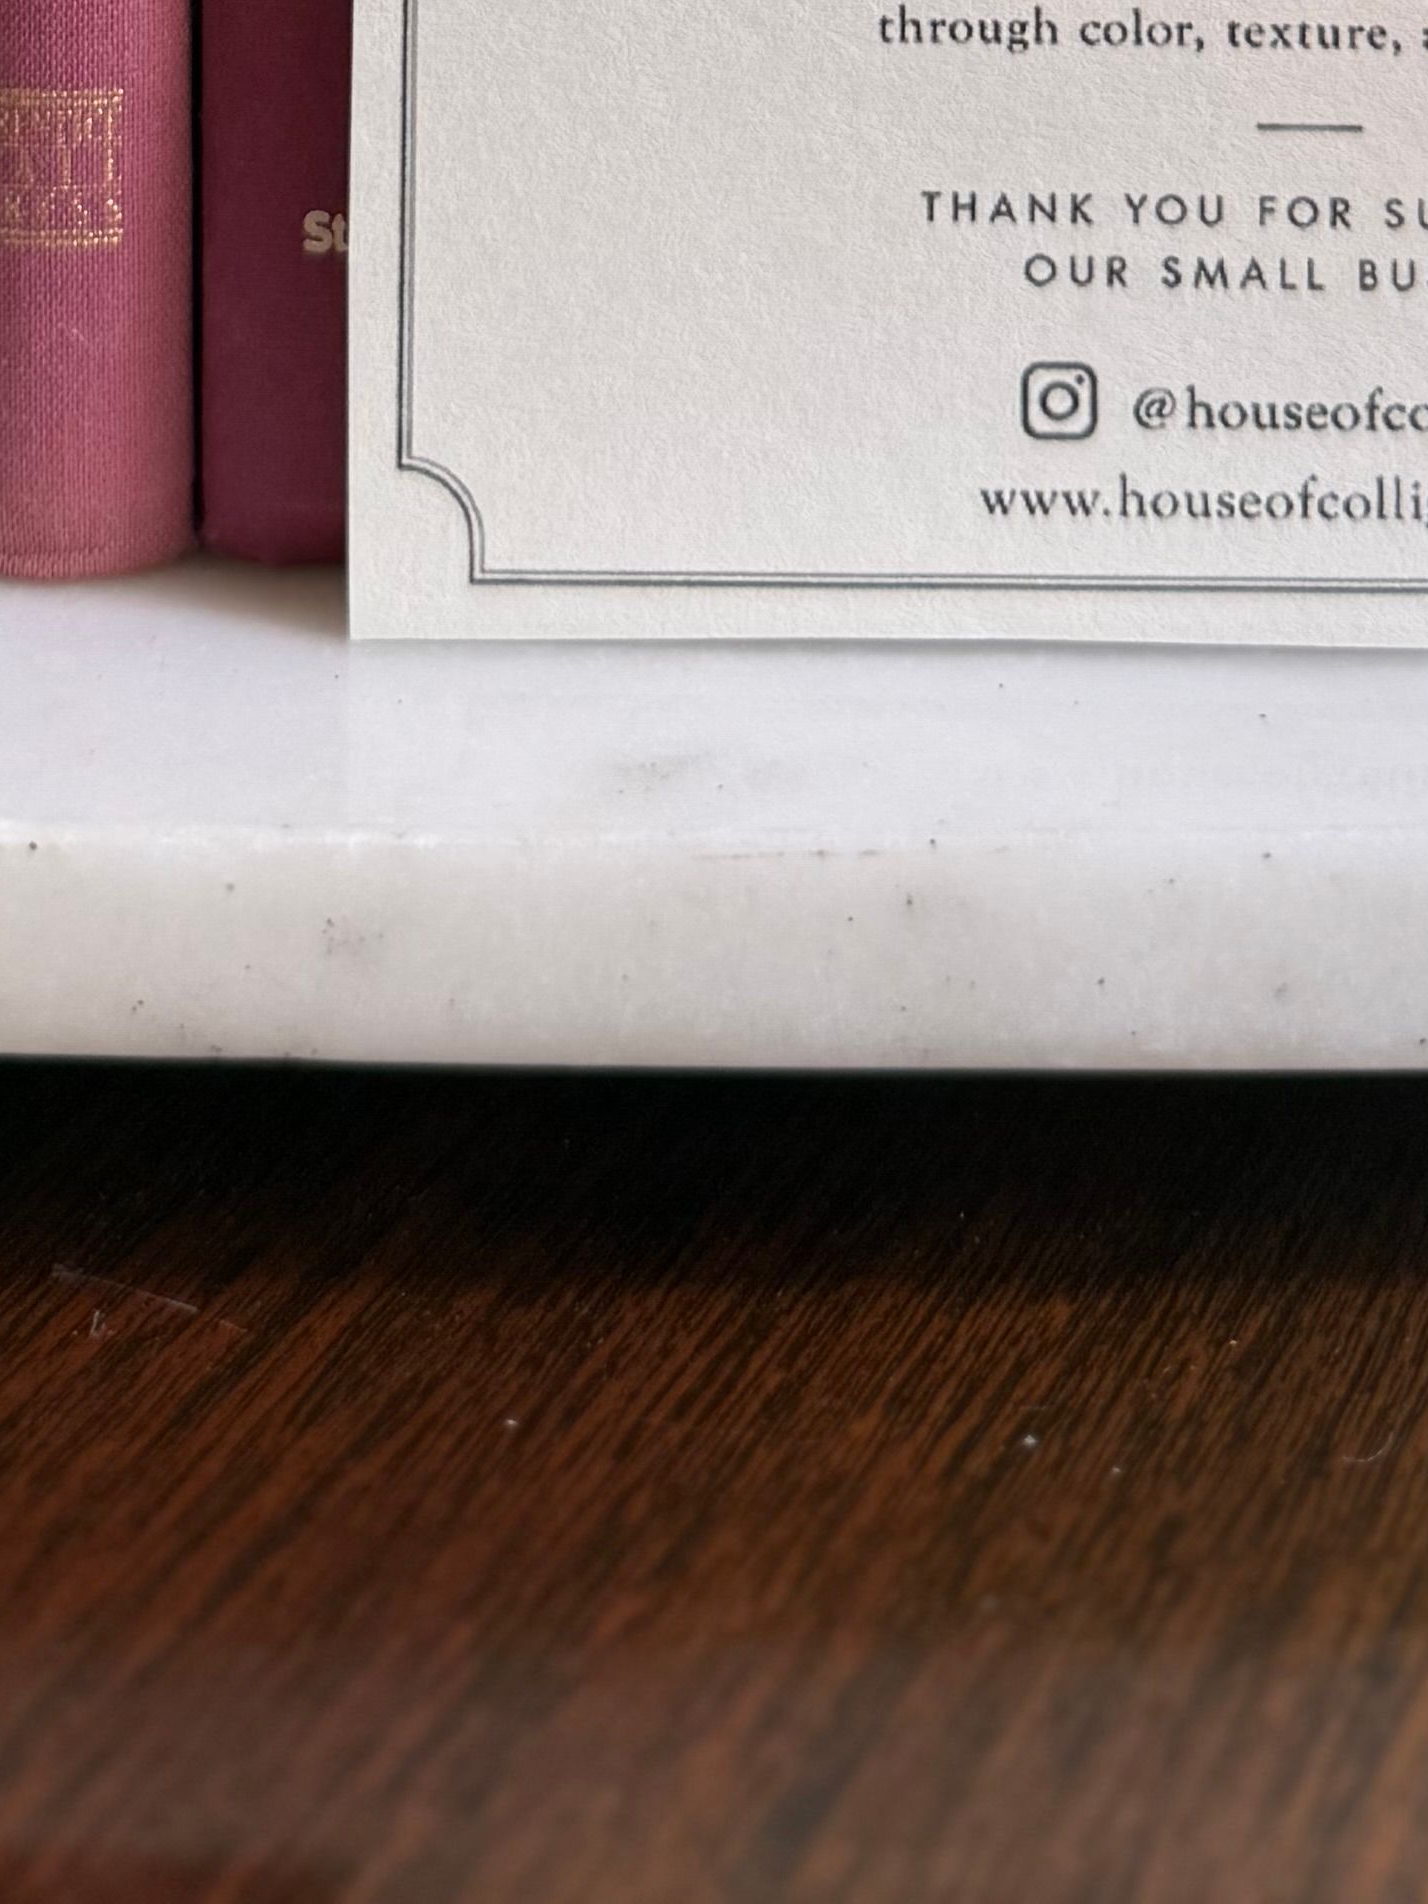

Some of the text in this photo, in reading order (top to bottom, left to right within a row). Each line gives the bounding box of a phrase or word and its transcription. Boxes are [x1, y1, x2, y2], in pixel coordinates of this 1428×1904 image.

[879, 6, 1058, 54] through
[1079, 8, 1204, 53] color,
[1228, 21, 1401, 56] texture,
[921, 191, 1093, 226] THANK
[1125, 194, 1223, 228] YOU
[1259, 196, 1351, 230] FOR
[1024, 254, 1127, 288] OUR
[1162, 256, 1324, 291] SMALL
